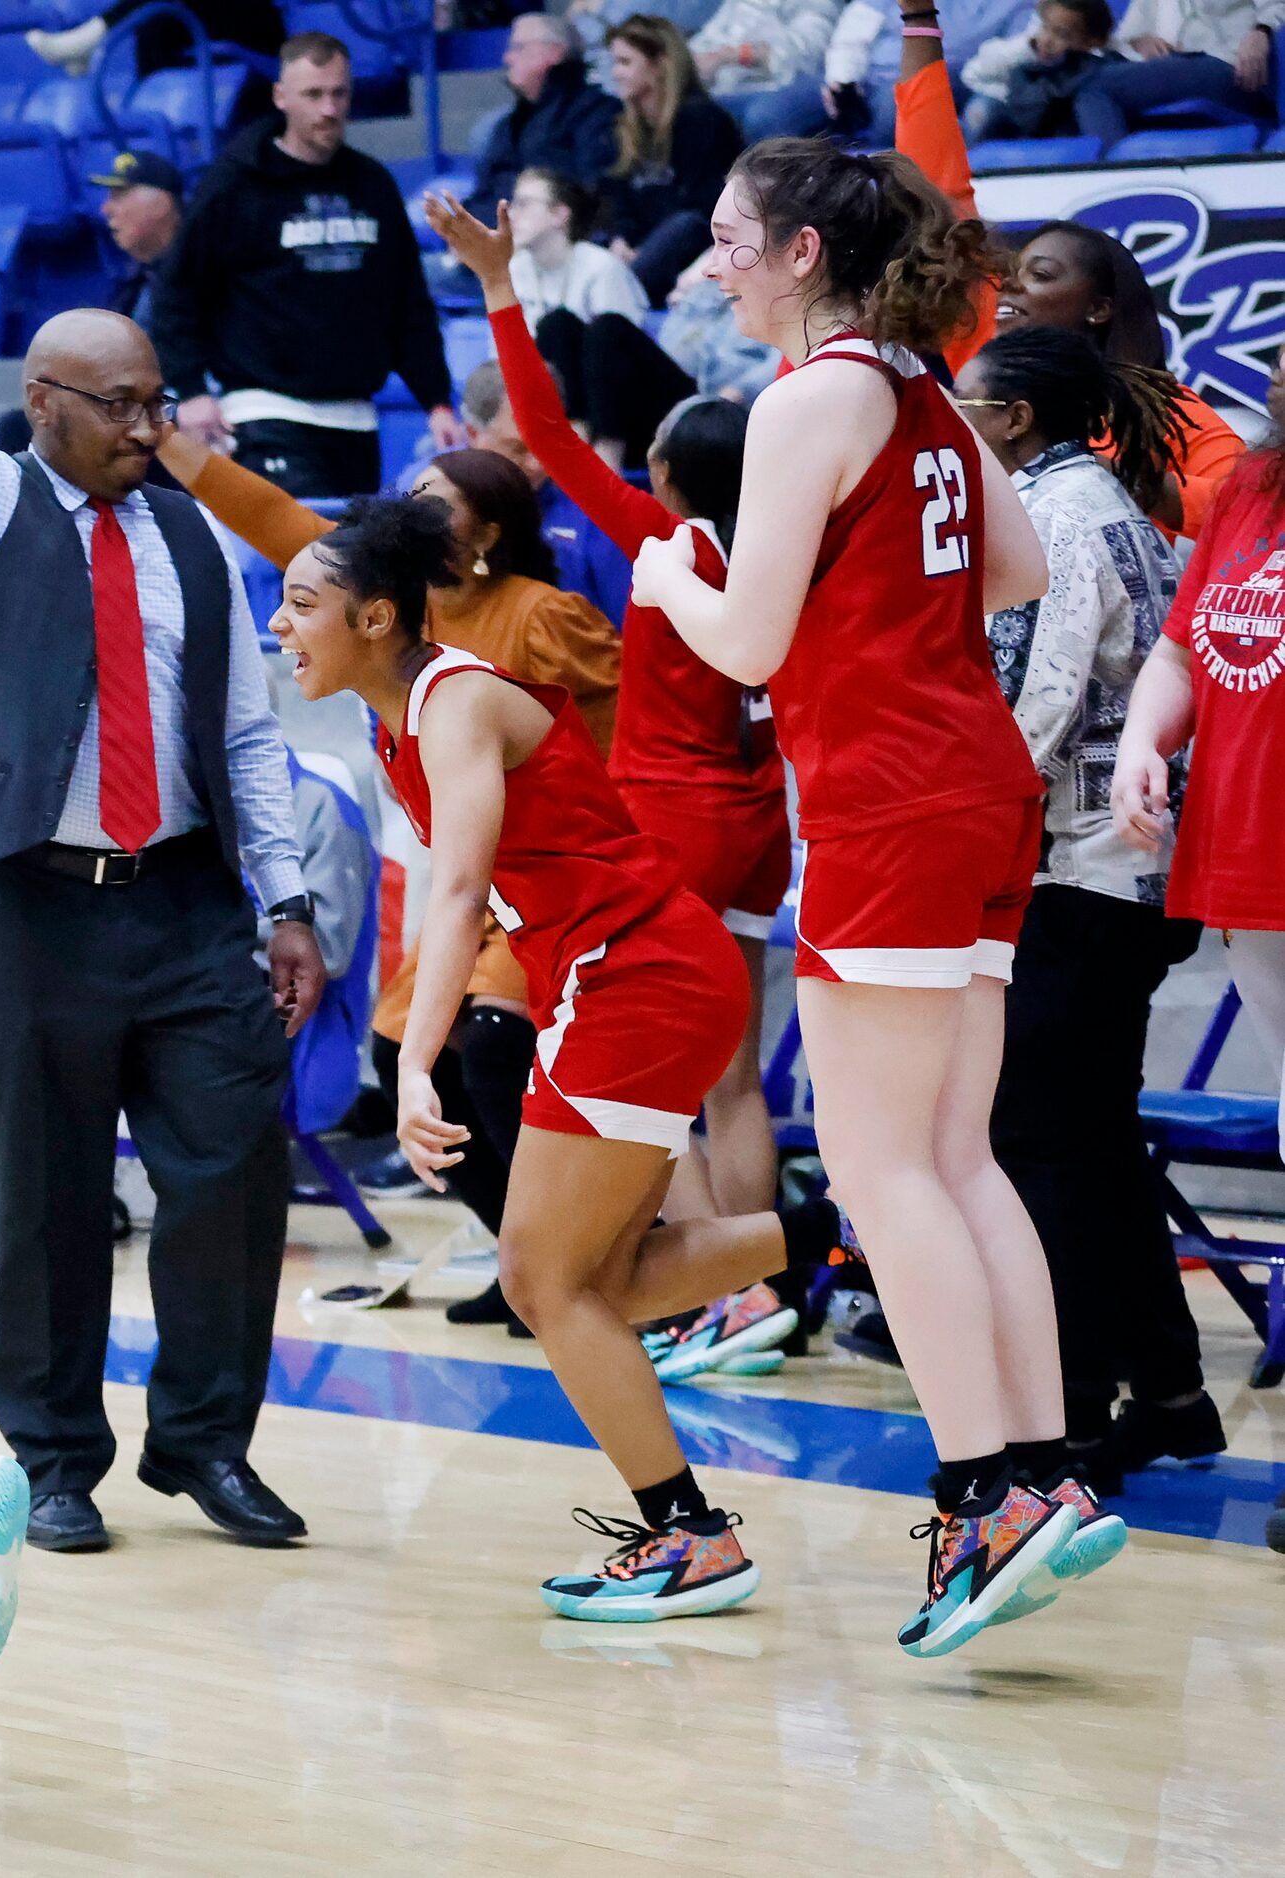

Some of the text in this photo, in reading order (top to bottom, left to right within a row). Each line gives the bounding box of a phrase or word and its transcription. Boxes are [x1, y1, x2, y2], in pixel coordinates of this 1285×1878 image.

[1242, 571, 1284, 598] Lady
[1209, 614, 1283, 638] BASKETBALL
[1191, 613, 1285, 693] DISTRICT CHAM
